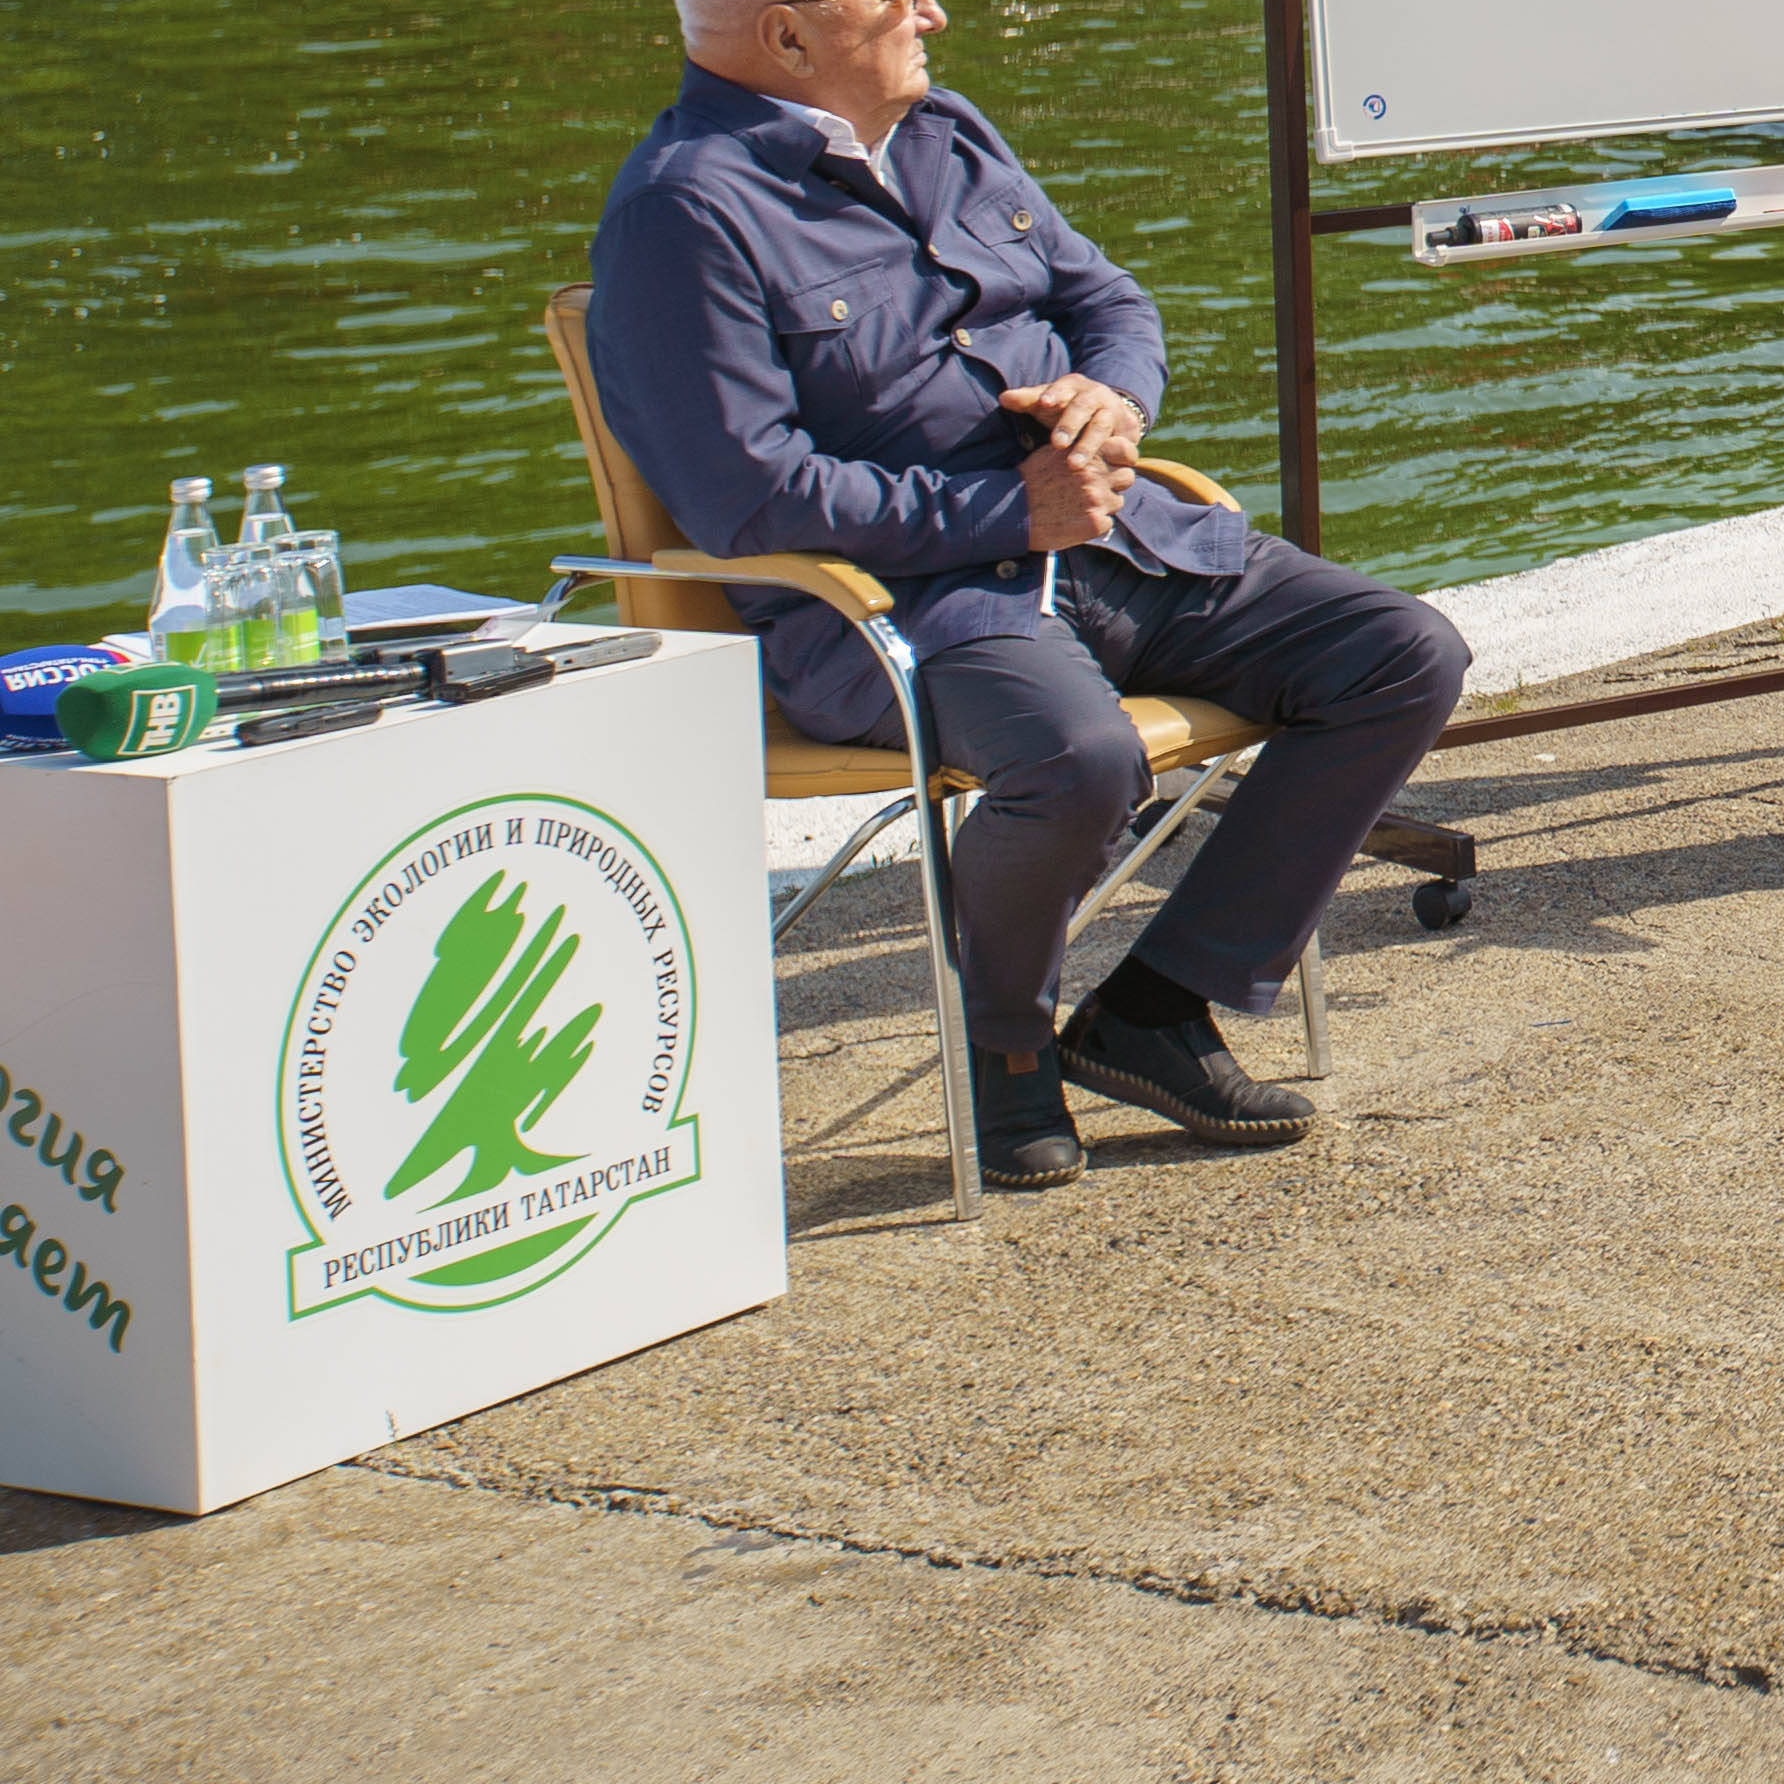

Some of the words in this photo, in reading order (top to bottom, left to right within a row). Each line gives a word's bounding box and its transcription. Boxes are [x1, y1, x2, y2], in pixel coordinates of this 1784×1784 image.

[137, 692, 182, 752] ТНВ
[298, 949, 357, 1223] МИНИСТЕРСТВО
[351, 822, 495, 944] ЭКОЛОГИИ
[505, 817, 524, 846] И
[535, 817, 668, 944] ПРИРОДНЫХ
[641, 948, 680, 1116] РЕСУРСОВ
[323, 1200, 512, 1290] РЕСПУБЛИКИ
[519, 1145, 672, 1223] ТАТАРСТАН
